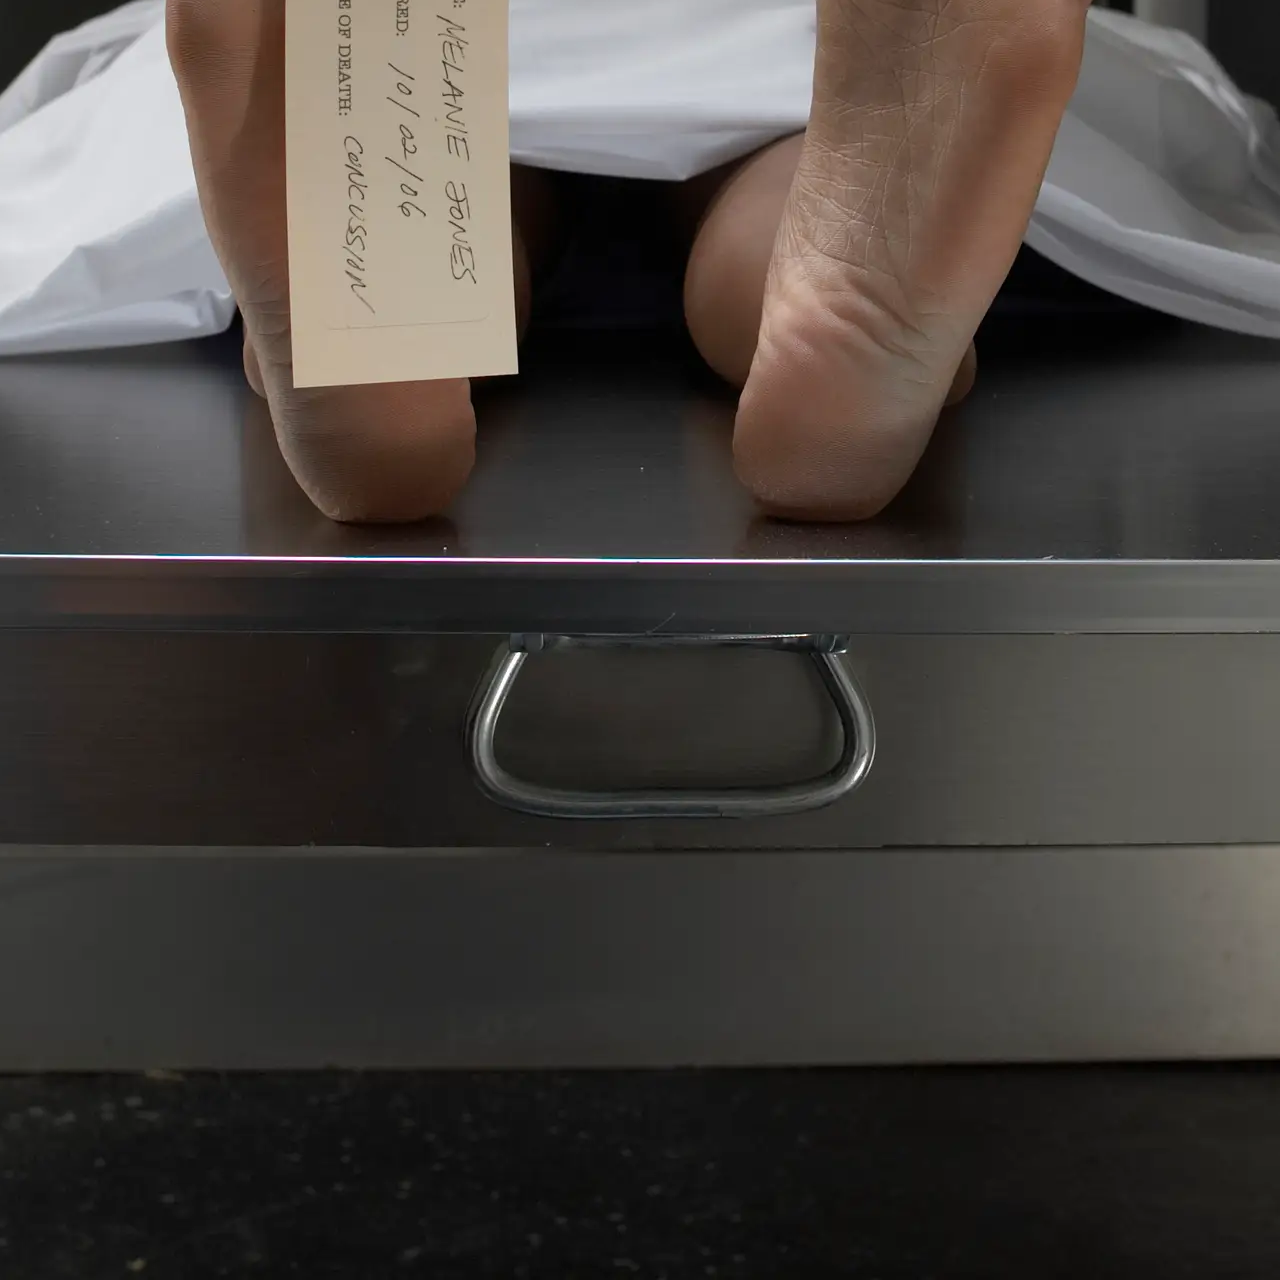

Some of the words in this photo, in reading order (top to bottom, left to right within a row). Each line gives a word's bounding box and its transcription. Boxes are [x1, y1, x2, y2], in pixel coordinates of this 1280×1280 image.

[337, 14, 352, 39] OF
[337, 43, 352, 117] DEATH:
[436, 14, 470, 162] MELANIE
[342, 135, 376, 315] CONCUSSION
[445, 181, 477, 285] JONES
